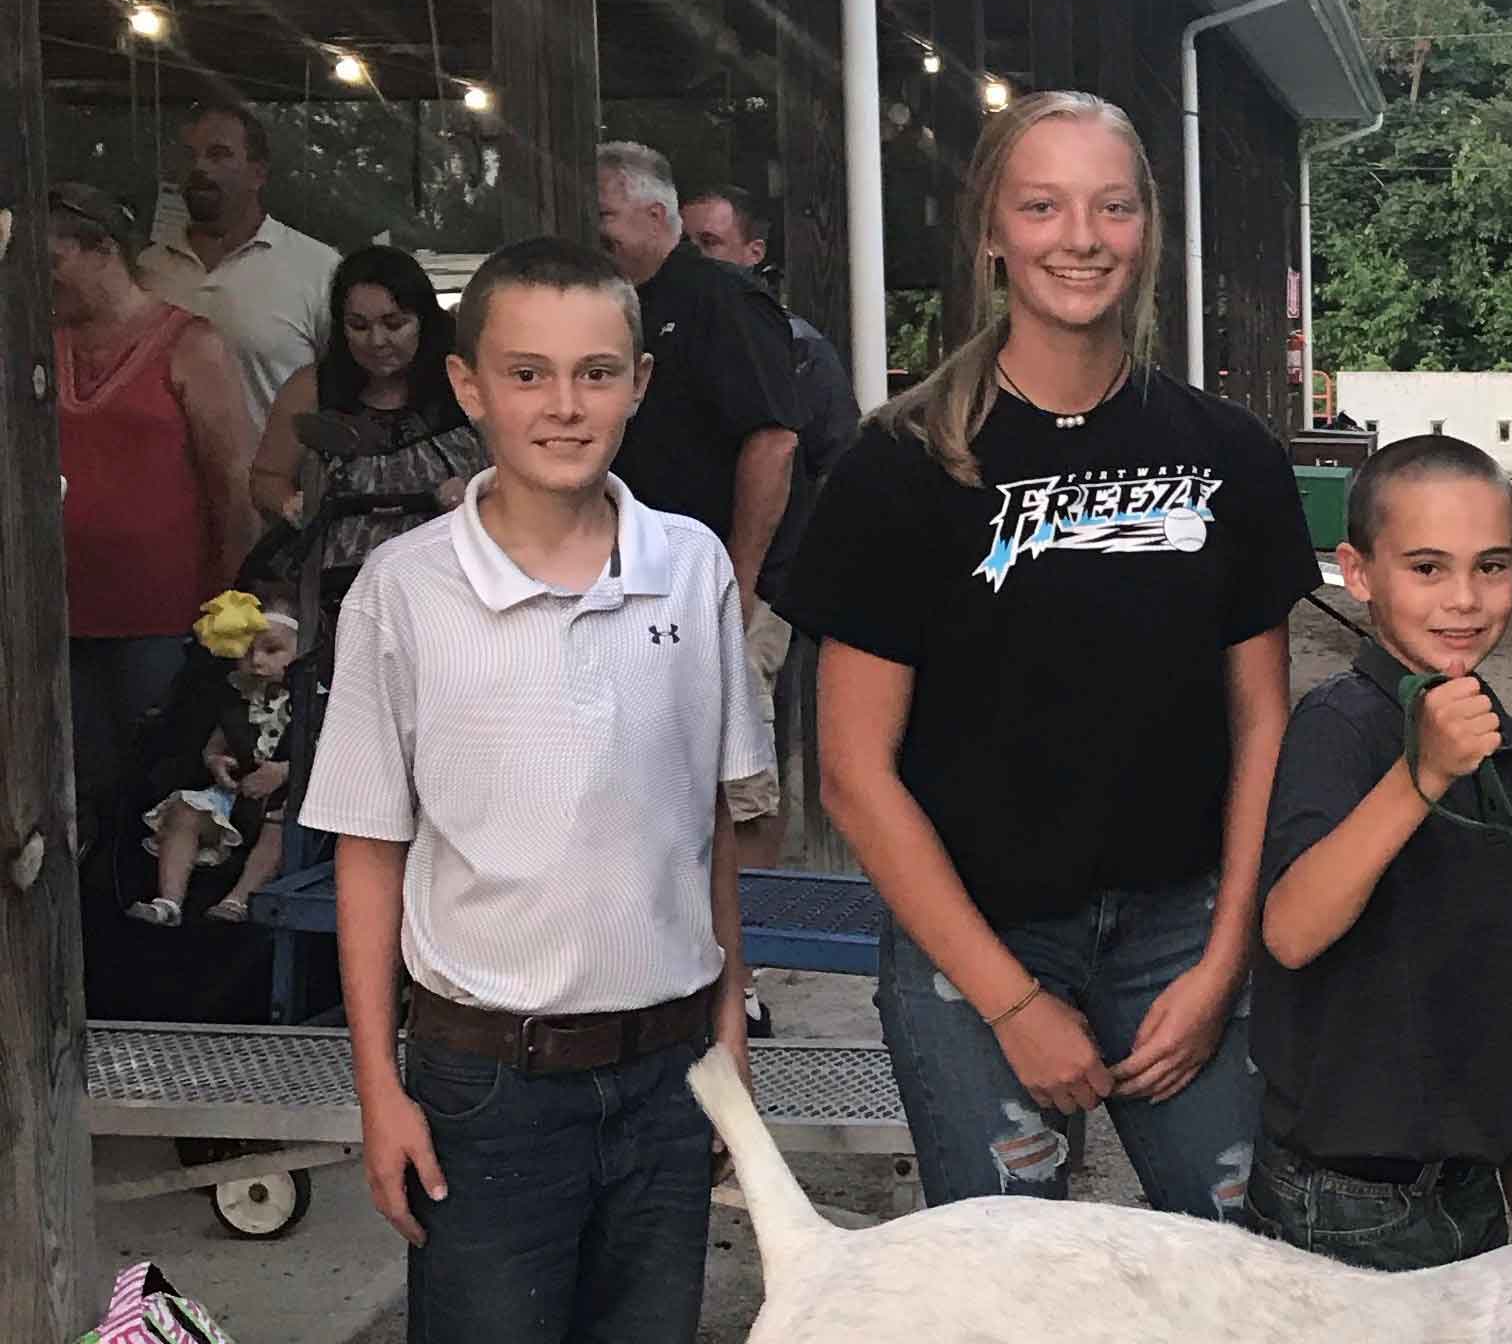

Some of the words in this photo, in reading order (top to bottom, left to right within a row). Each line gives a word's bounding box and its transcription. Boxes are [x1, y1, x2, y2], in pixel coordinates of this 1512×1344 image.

[1067, 468, 1127, 483] FORT
[1136, 460, 1212, 478] WAYNE
[972, 475, 1223, 593] FREEZE
